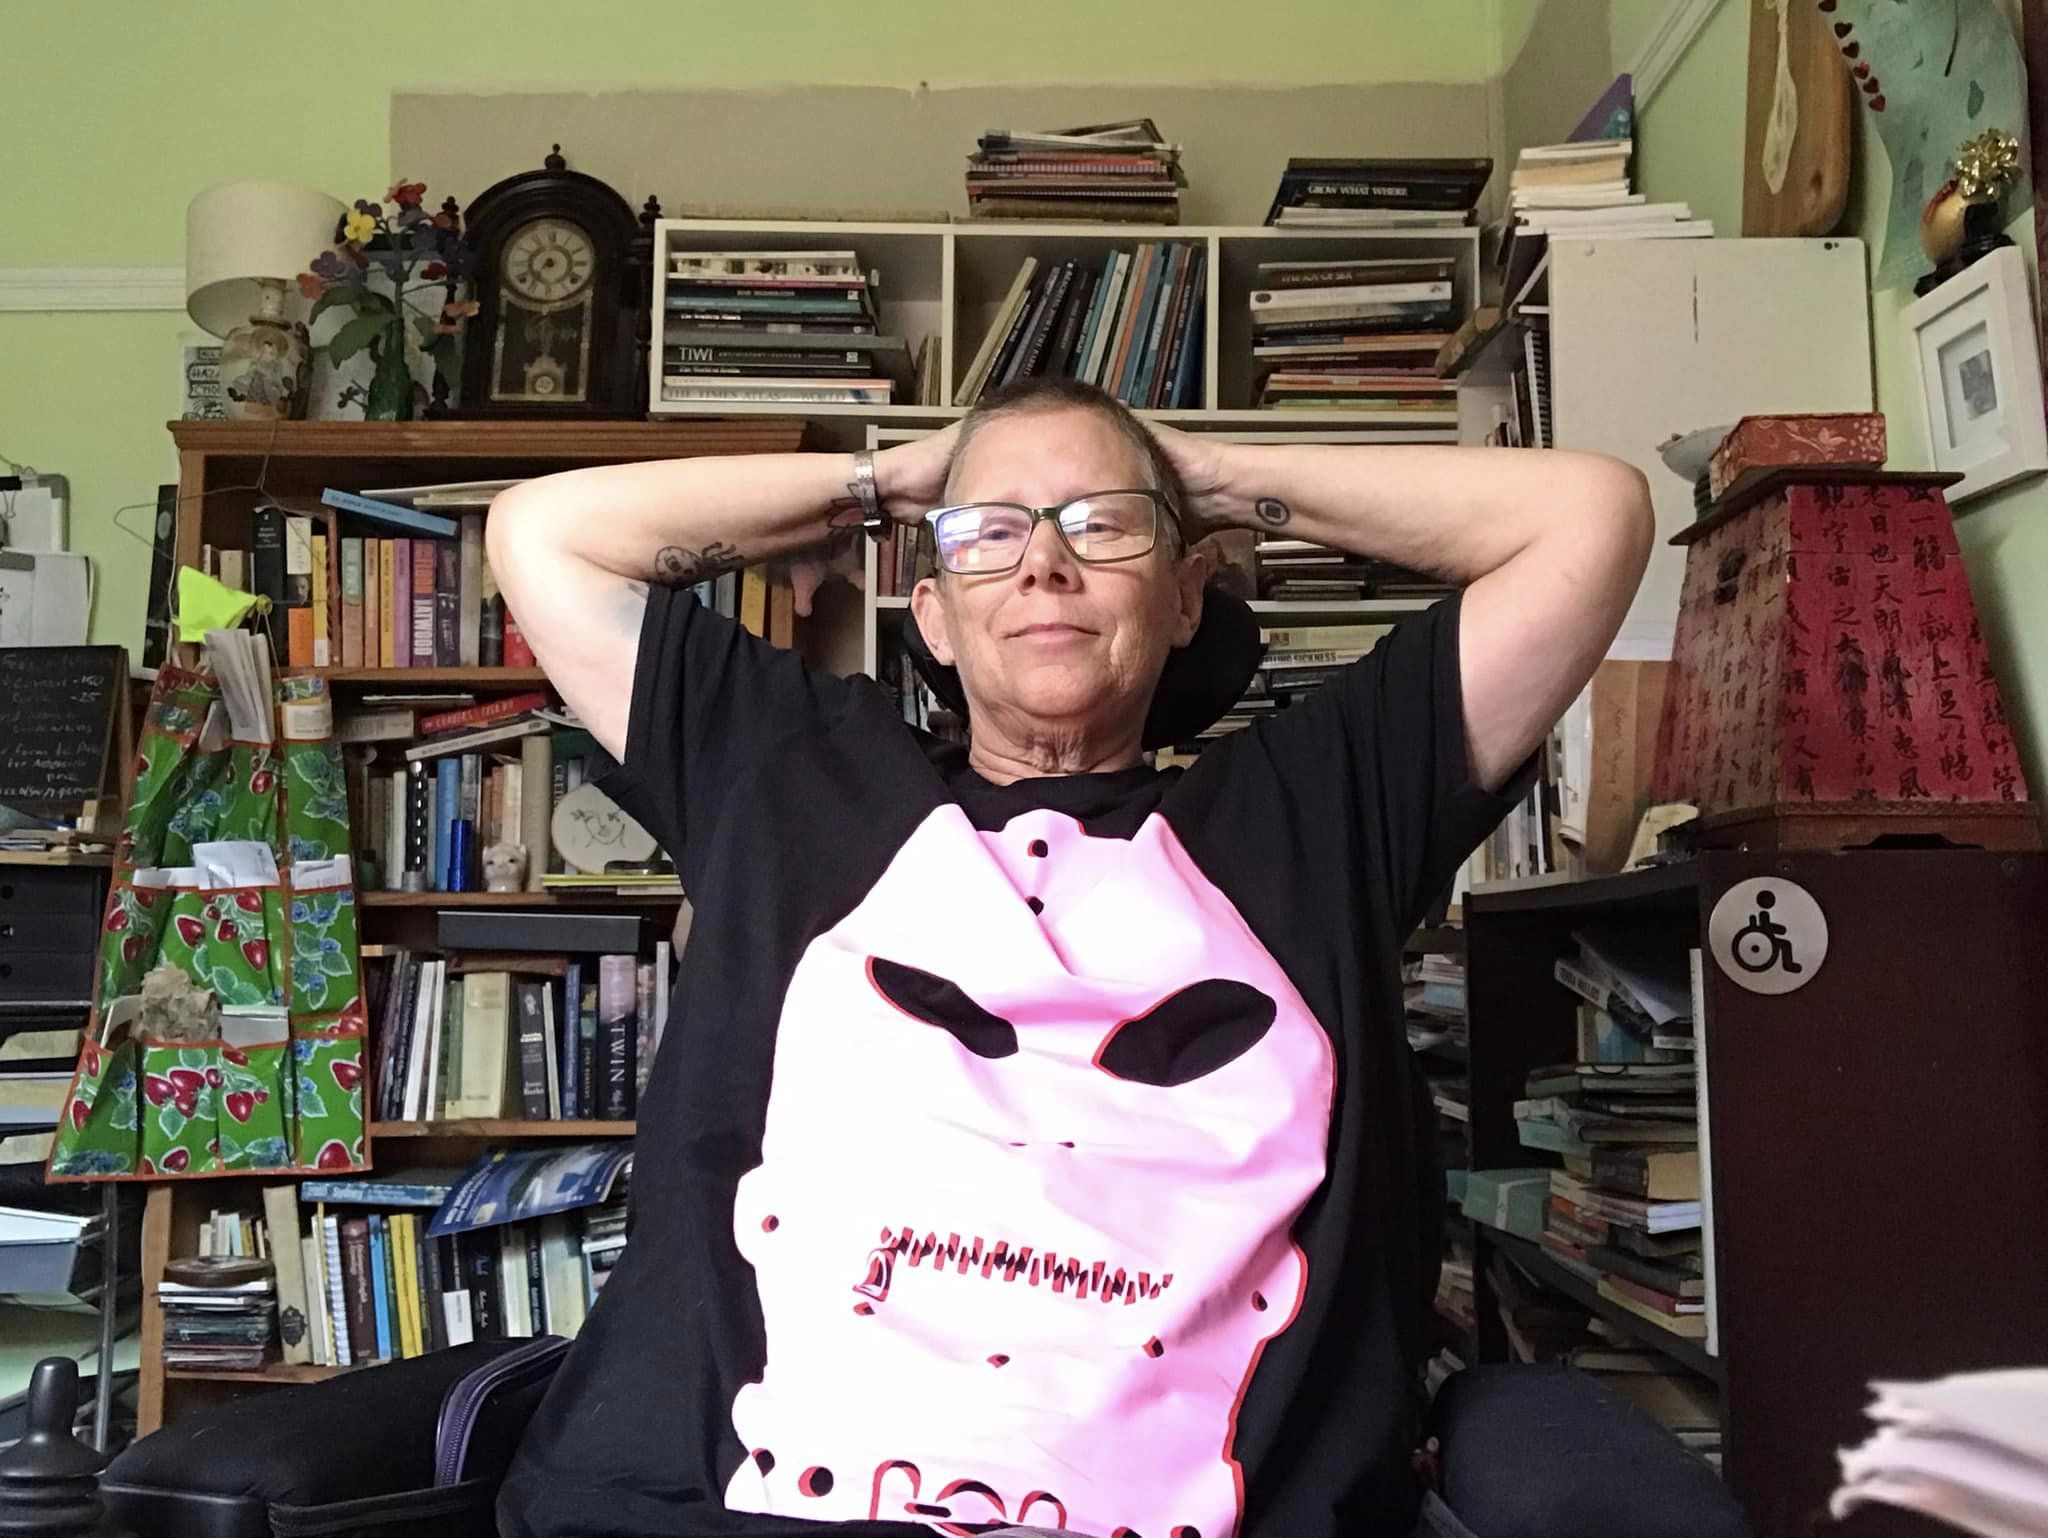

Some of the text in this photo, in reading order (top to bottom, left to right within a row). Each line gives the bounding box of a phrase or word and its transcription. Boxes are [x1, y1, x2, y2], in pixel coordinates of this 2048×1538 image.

[1308, 185, 1408, 196] GROW WHAT WHERE
[679, 347, 713, 361] TIWI
[414, 606, 433, 656] ATWOOD
[1293, 651, 1337, 664] SICKNESS
